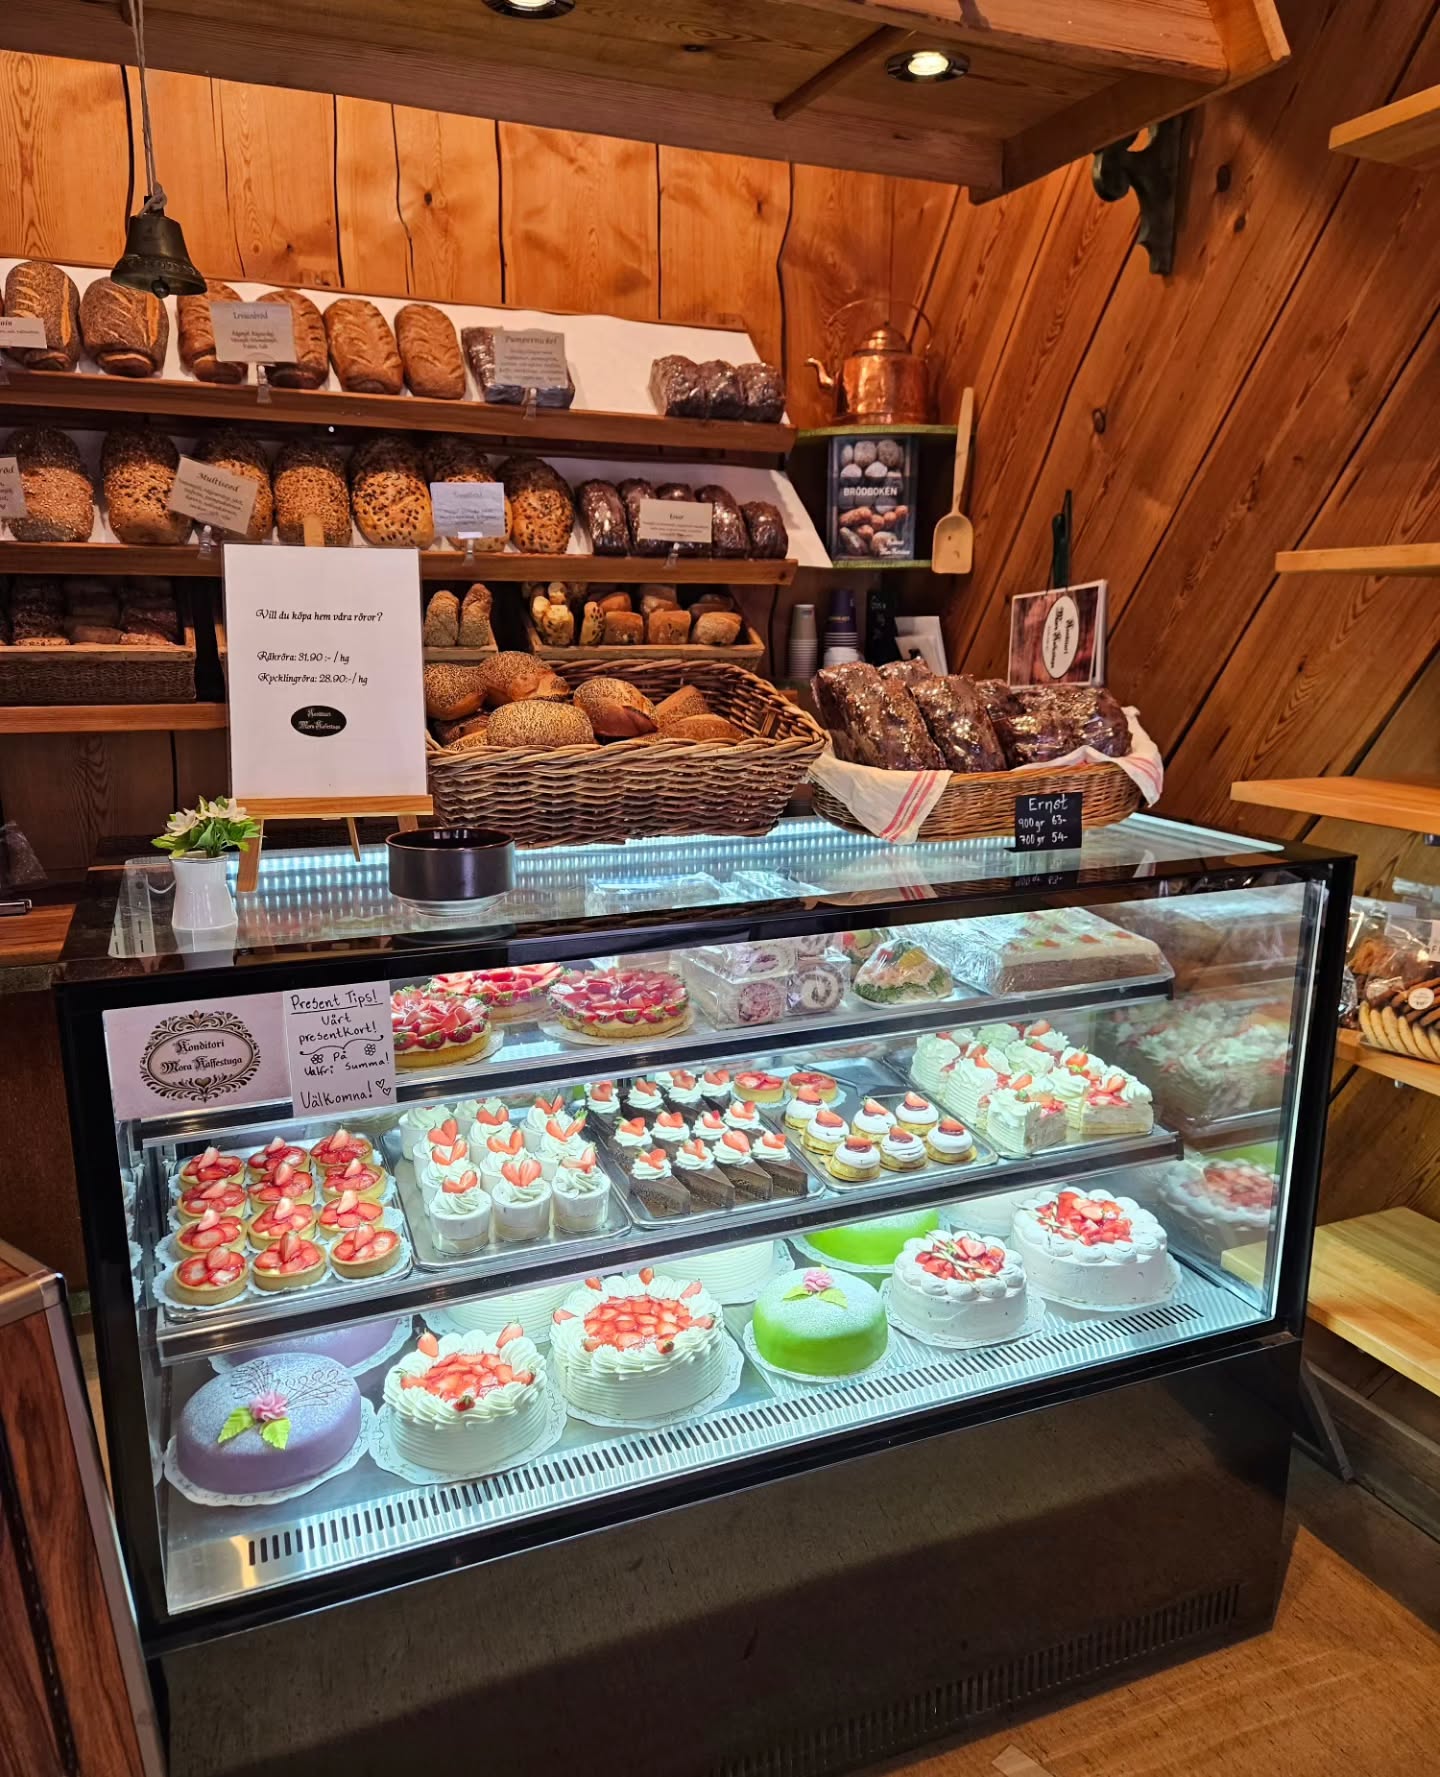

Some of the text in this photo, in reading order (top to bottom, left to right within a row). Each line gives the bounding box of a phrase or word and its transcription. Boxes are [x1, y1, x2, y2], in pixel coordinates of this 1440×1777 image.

[843, 486, 898, 496] BRÖDBOKEN
[255, 608, 383, 622] Vill du köpa hem våra röror?
[256, 651, 297, 663] Räkröra:
[340, 654, 350, 665] hg
[257, 672, 317, 685] Kycklingröra:
[358, 675, 368, 686] hg
[1028, 793, 1068, 814] Ernst
[1019, 833, 1035, 845] 700
[290, 988, 378, 1011] Present Tips!
[172, 1039, 225, 1056] Konditori
[160, 1056, 242, 1075] Mora Kaffestuga
